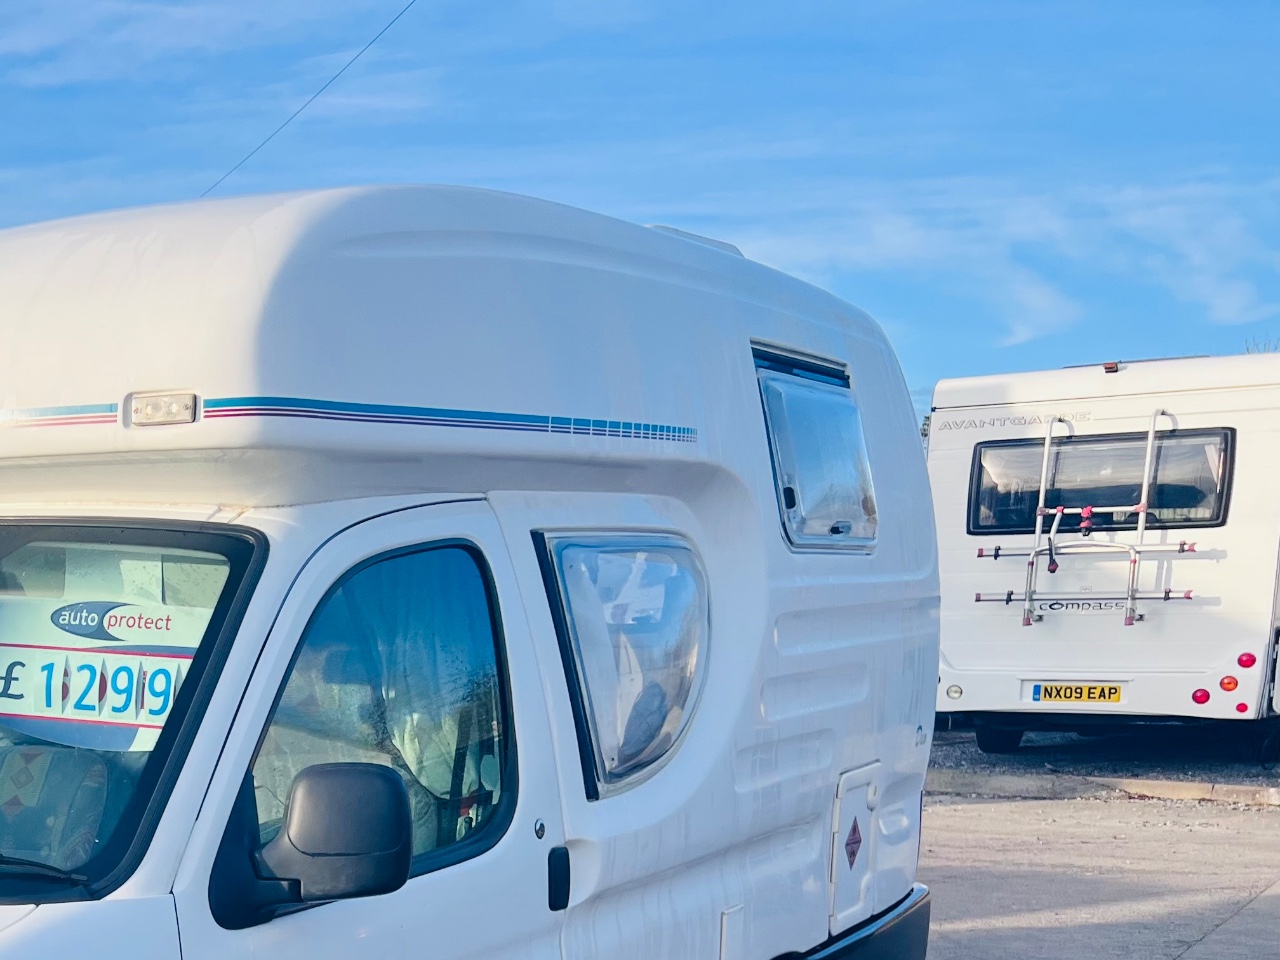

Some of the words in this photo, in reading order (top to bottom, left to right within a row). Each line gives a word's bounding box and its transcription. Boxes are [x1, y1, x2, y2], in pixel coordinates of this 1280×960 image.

[1039, 600, 1125, 612] compass
[58, 609, 99, 626] auto
[106, 613, 172, 631] protect
[1043, 686, 1083, 699] NX09
[1087, 686, 1118, 700] EAP
